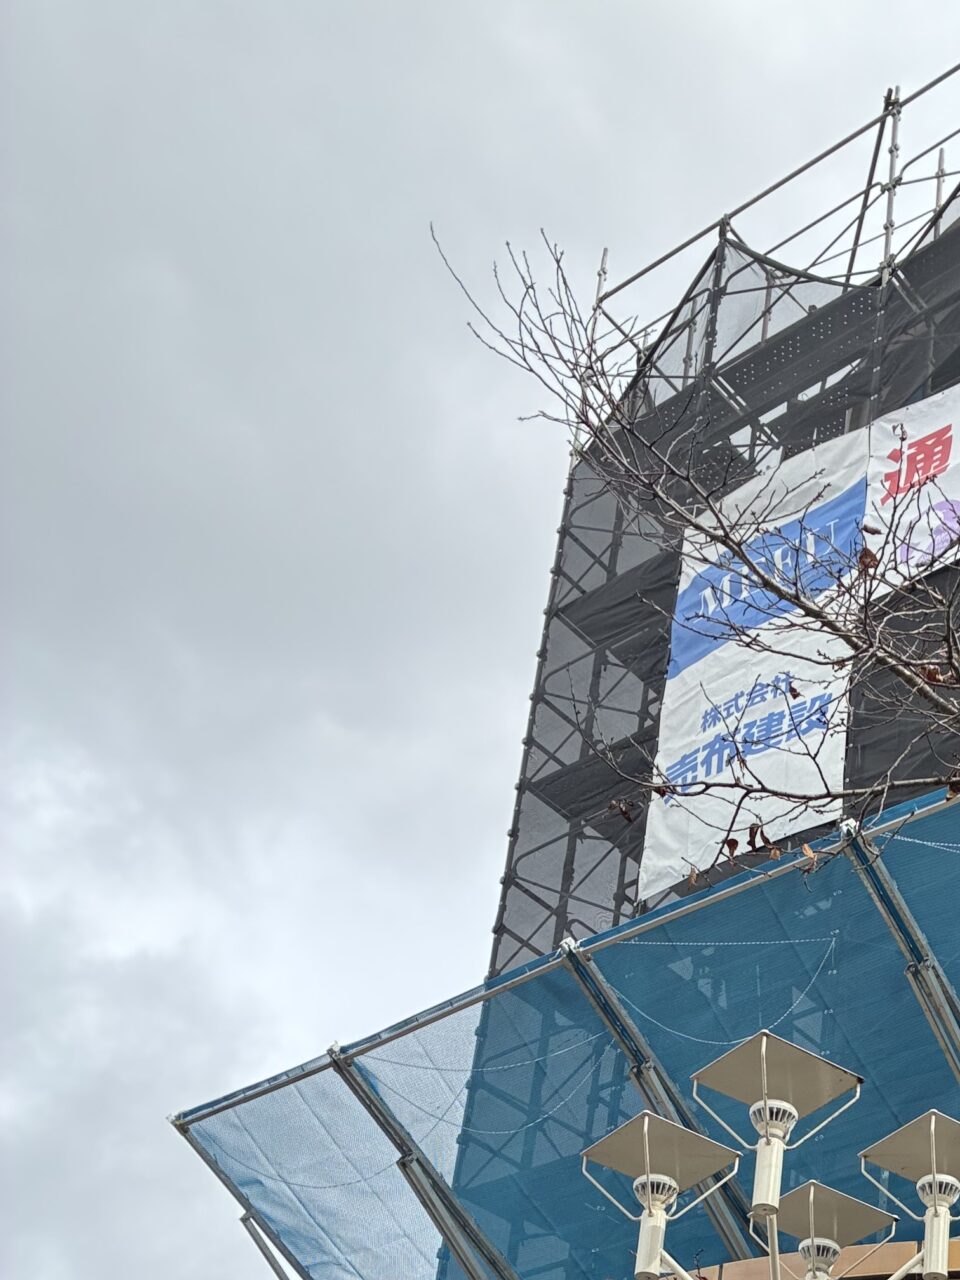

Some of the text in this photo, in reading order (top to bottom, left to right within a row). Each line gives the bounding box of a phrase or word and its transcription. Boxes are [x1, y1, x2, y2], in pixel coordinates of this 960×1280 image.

[700, 671, 795, 733] 株式会社
[663, 692, 833, 806] 売布建設
